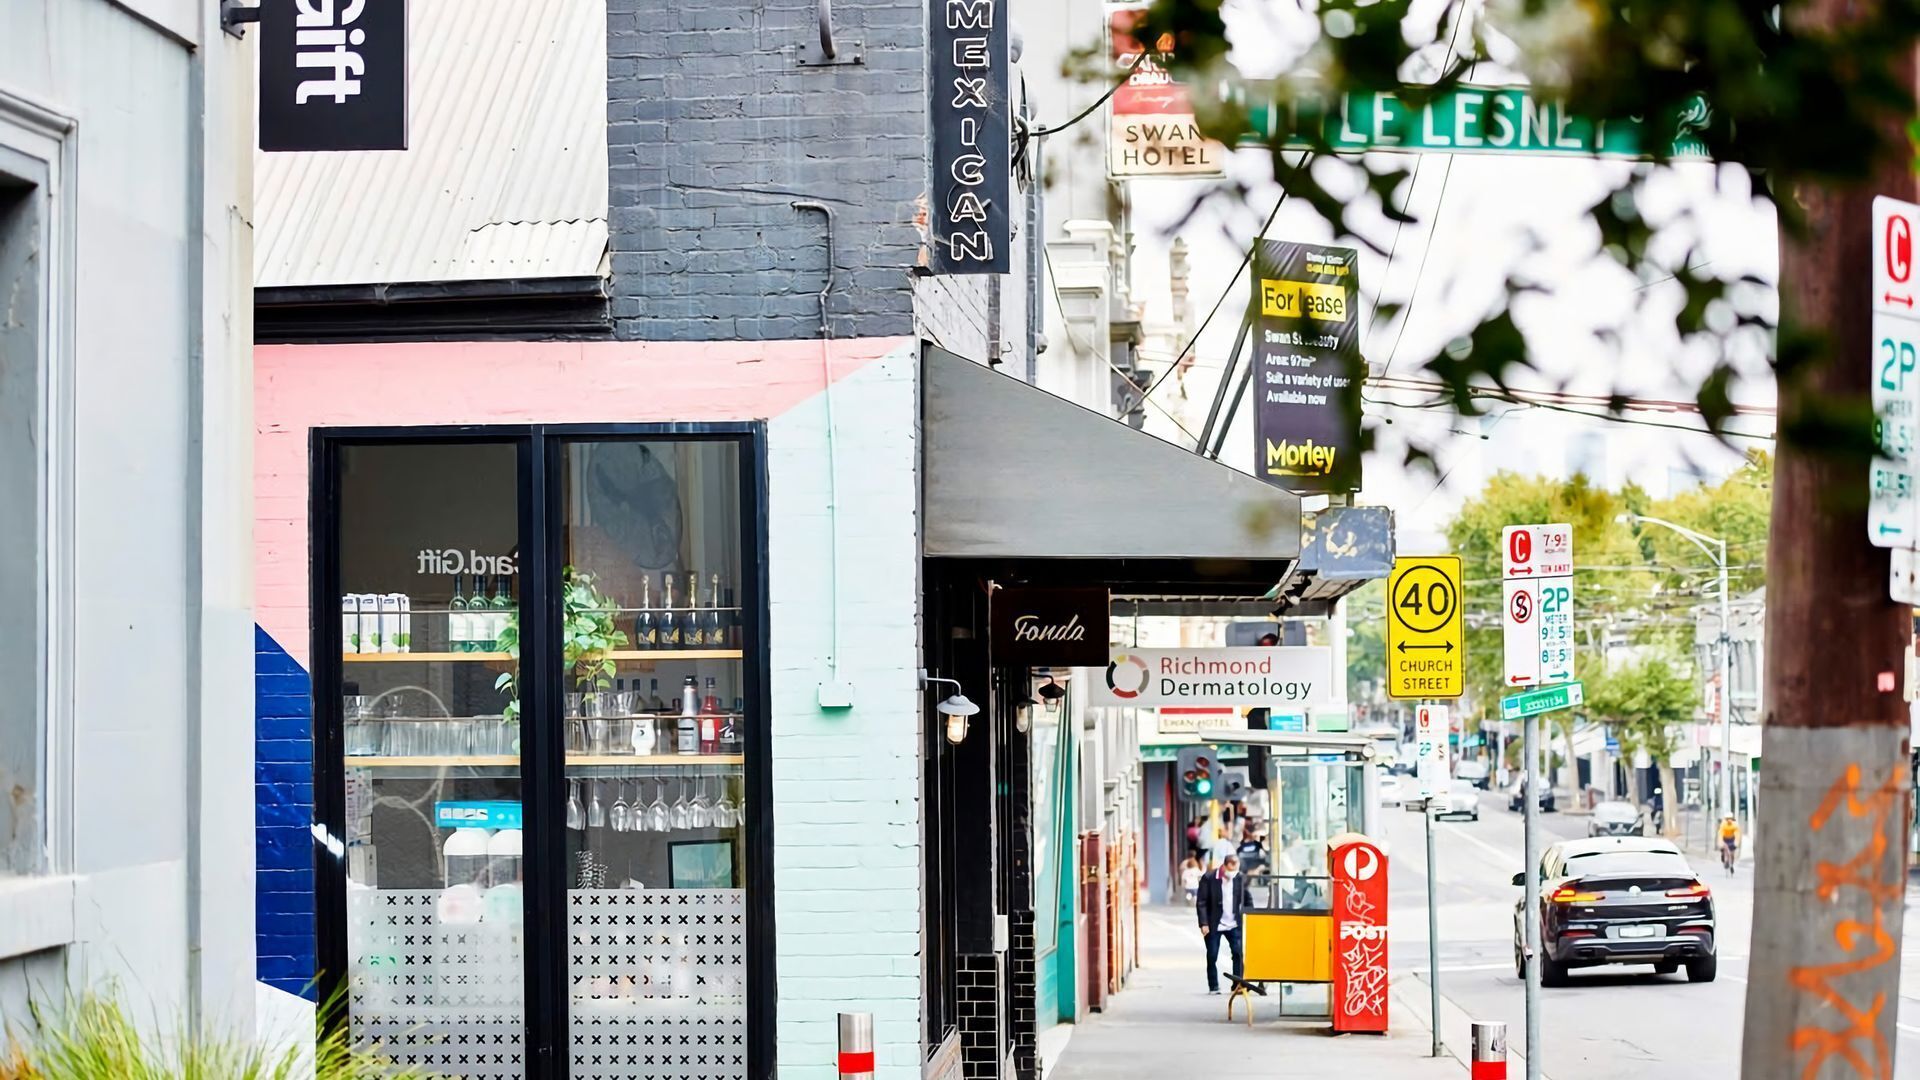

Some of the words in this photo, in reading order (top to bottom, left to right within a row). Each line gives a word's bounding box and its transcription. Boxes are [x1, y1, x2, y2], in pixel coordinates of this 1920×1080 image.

[946, 0, 993, 261] MEXICAN
[1421, 90, 1604, 149] LESNE
[1126, 122, 1205, 143] SWAN
[1123, 146, 1210, 166] HOTEL
[1264, 287, 1294, 311] For
[1880, 337, 1916, 391] 2P
[1266, 437, 1336, 474] Morley
[1400, 582, 1449, 616] 40
[1541, 587, 1570, 613] 2P
[1014, 613, 1086, 642] Fonda
[1160, 656, 1272, 675] Richmond
[1399, 659, 1453, 672] CHURCH
[1160, 678, 1312, 700] Dermatology
[1403, 677, 1450, 690] STREET
